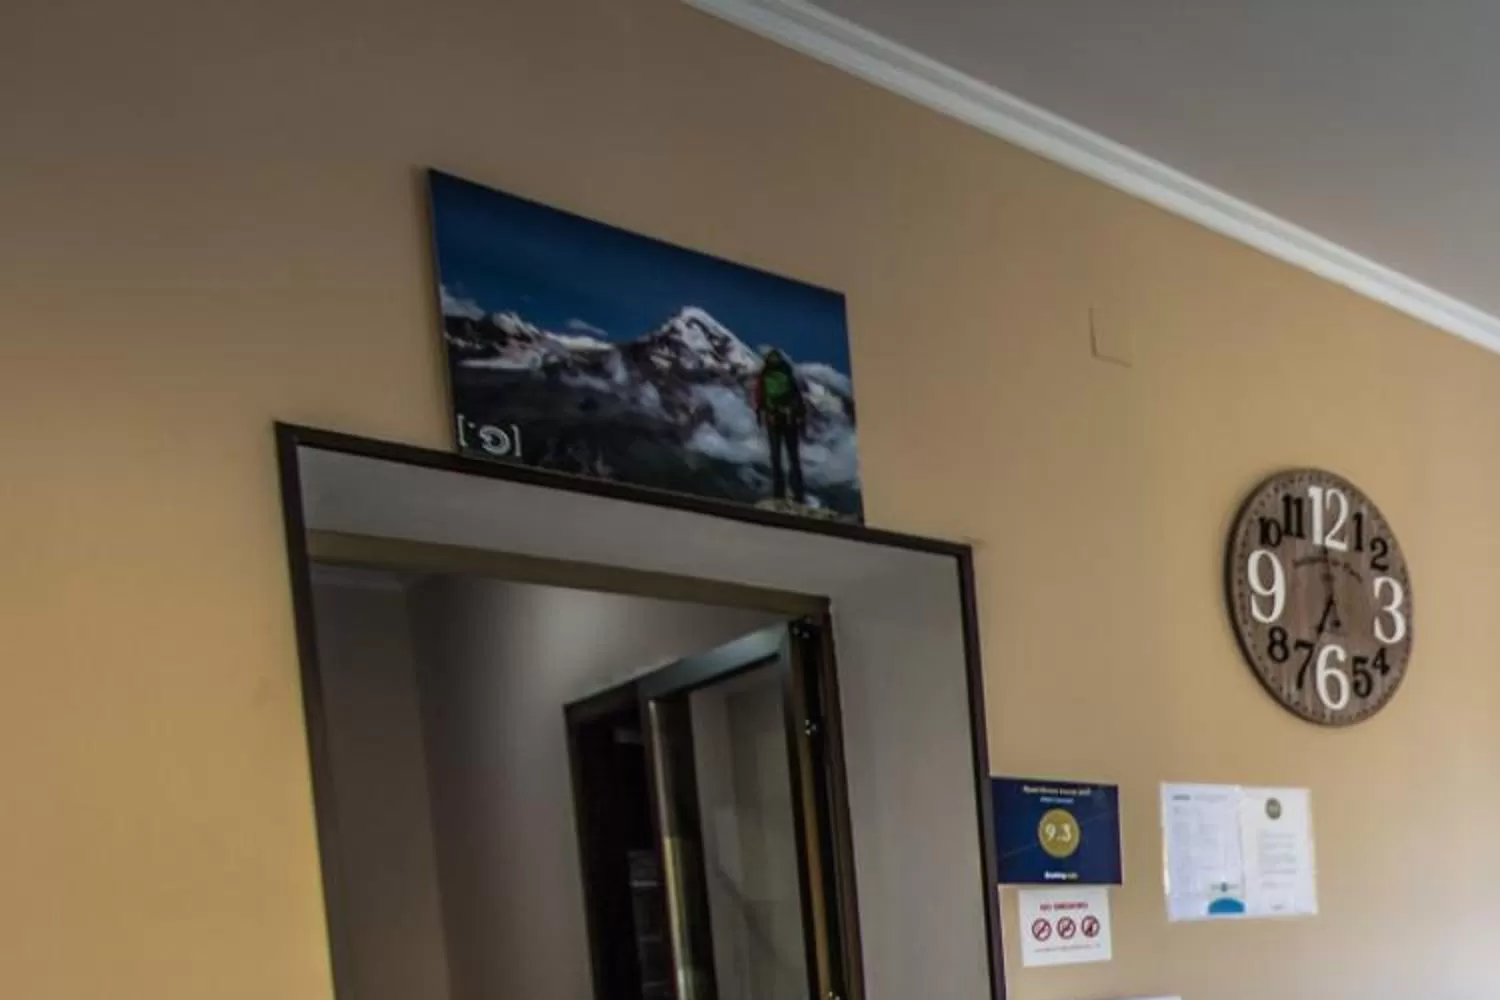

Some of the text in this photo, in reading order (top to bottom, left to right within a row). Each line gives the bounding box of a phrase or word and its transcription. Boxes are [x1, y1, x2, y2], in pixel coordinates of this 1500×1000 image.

[1259, 516, 1281, 548] 10
[1282, 494, 1304, 539] 11
[1308, 485, 1349, 552] 12
[1353, 511, 1364, 552] 1
[1370, 537, 1388, 573] 2
[1248, 550, 1286, 624] 9
[1373, 577, 1406, 644] 3
[1268, 627, 1289, 663] 8
[1294, 640, 1314, 690] 7
[1372, 647, 1390, 675] 4
[1316, 644, 1350, 710] 6
[1352, 656, 1372, 699] 5
